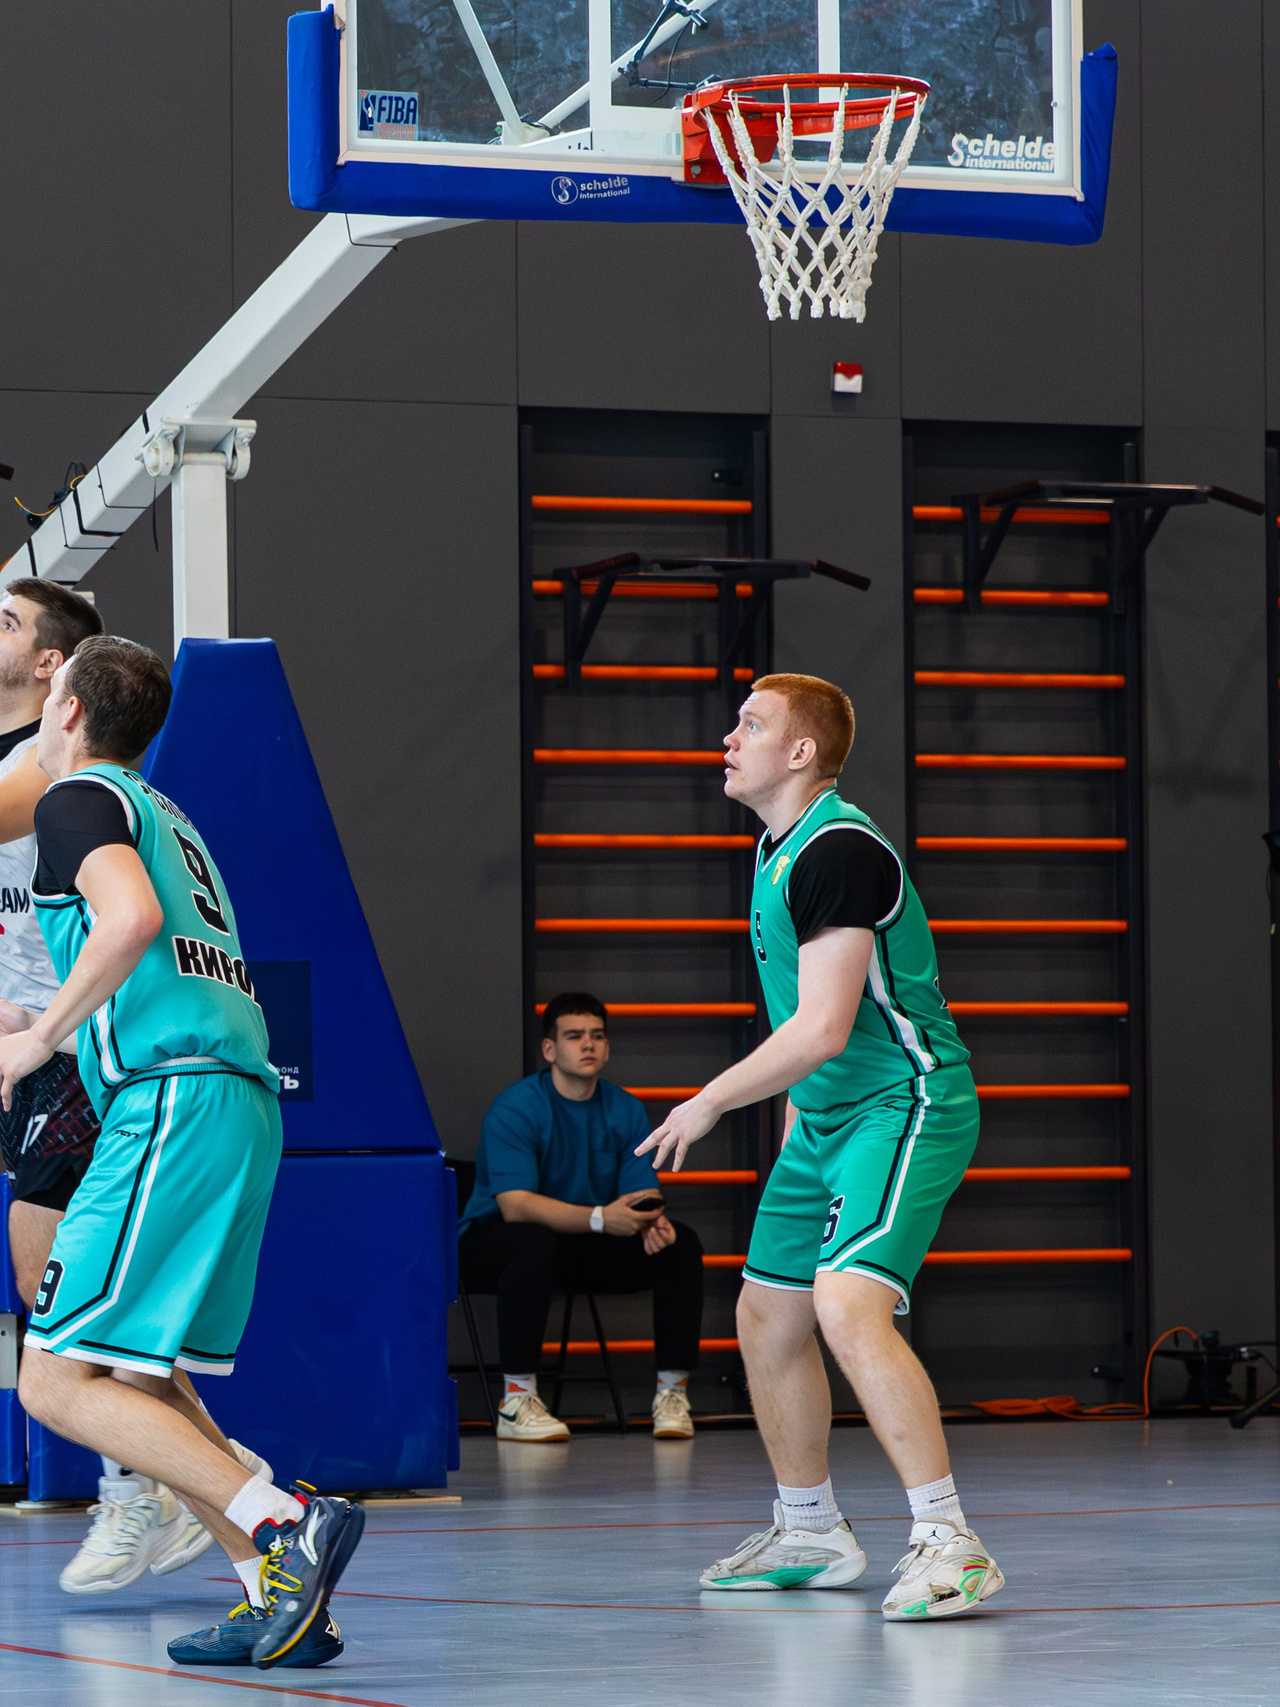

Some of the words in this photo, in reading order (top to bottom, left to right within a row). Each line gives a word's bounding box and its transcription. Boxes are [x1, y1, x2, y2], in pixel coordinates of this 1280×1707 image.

[377, 95, 418, 125] FIBA
[965, 155, 1054, 172] international
[580, 176, 629, 191] schelde
[580, 187, 631, 199] international
[171, 824, 231, 936] 9
[172, 935, 261, 1009] КИРО
[21, 1113, 48, 1154] 17
[32, 1258, 65, 1317] 9
